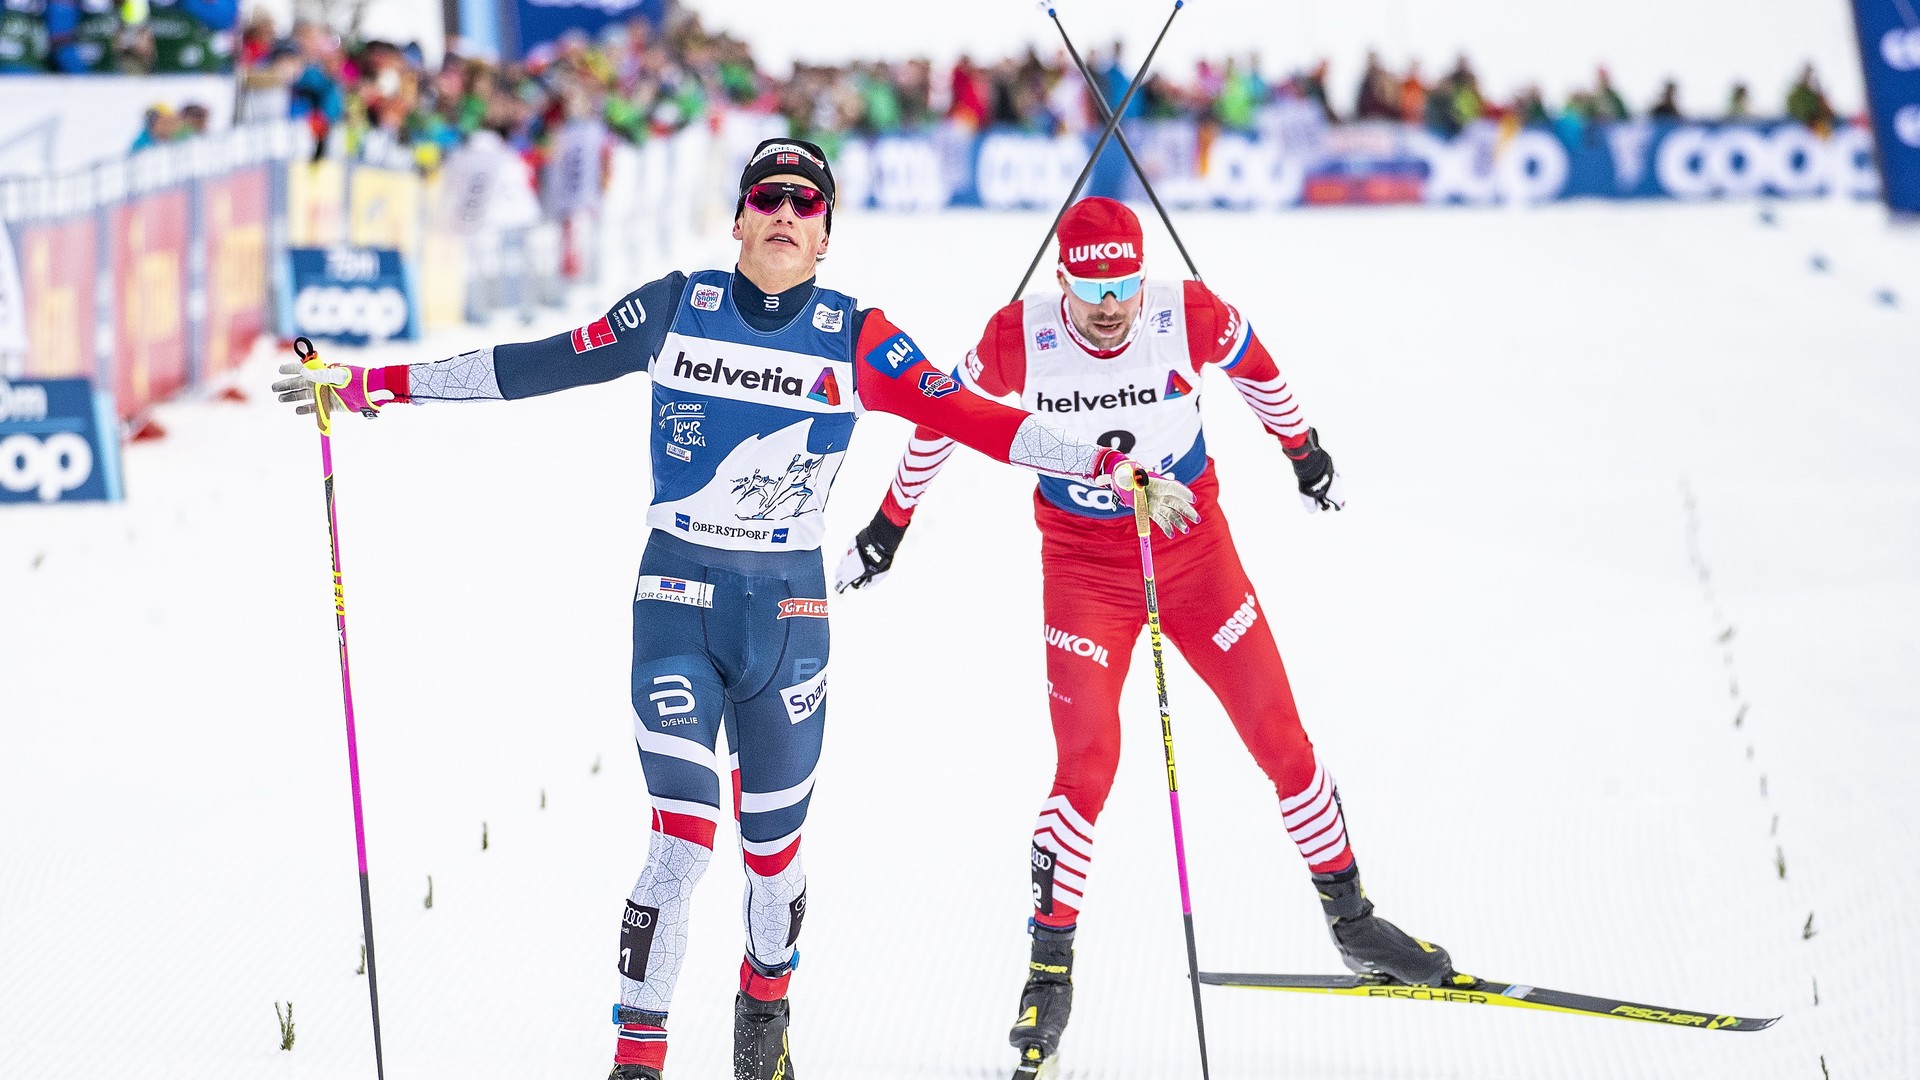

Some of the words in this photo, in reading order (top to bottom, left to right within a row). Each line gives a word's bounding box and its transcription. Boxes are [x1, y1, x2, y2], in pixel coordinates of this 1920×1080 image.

[1068, 241, 1137, 264] LUKOIL
[295, 286, 407, 342] coop
[673, 351, 803, 397] helvetia
[678, 403, 702, 412] coop
[1037, 384, 1157, 413] helvetia
[692, 521, 770, 540] OBERSTDORF
[661, 716, 698, 728] DÆHLIE
[621, 947, 632, 974] 1
[1610, 1005, 1707, 1026] FISCHER
